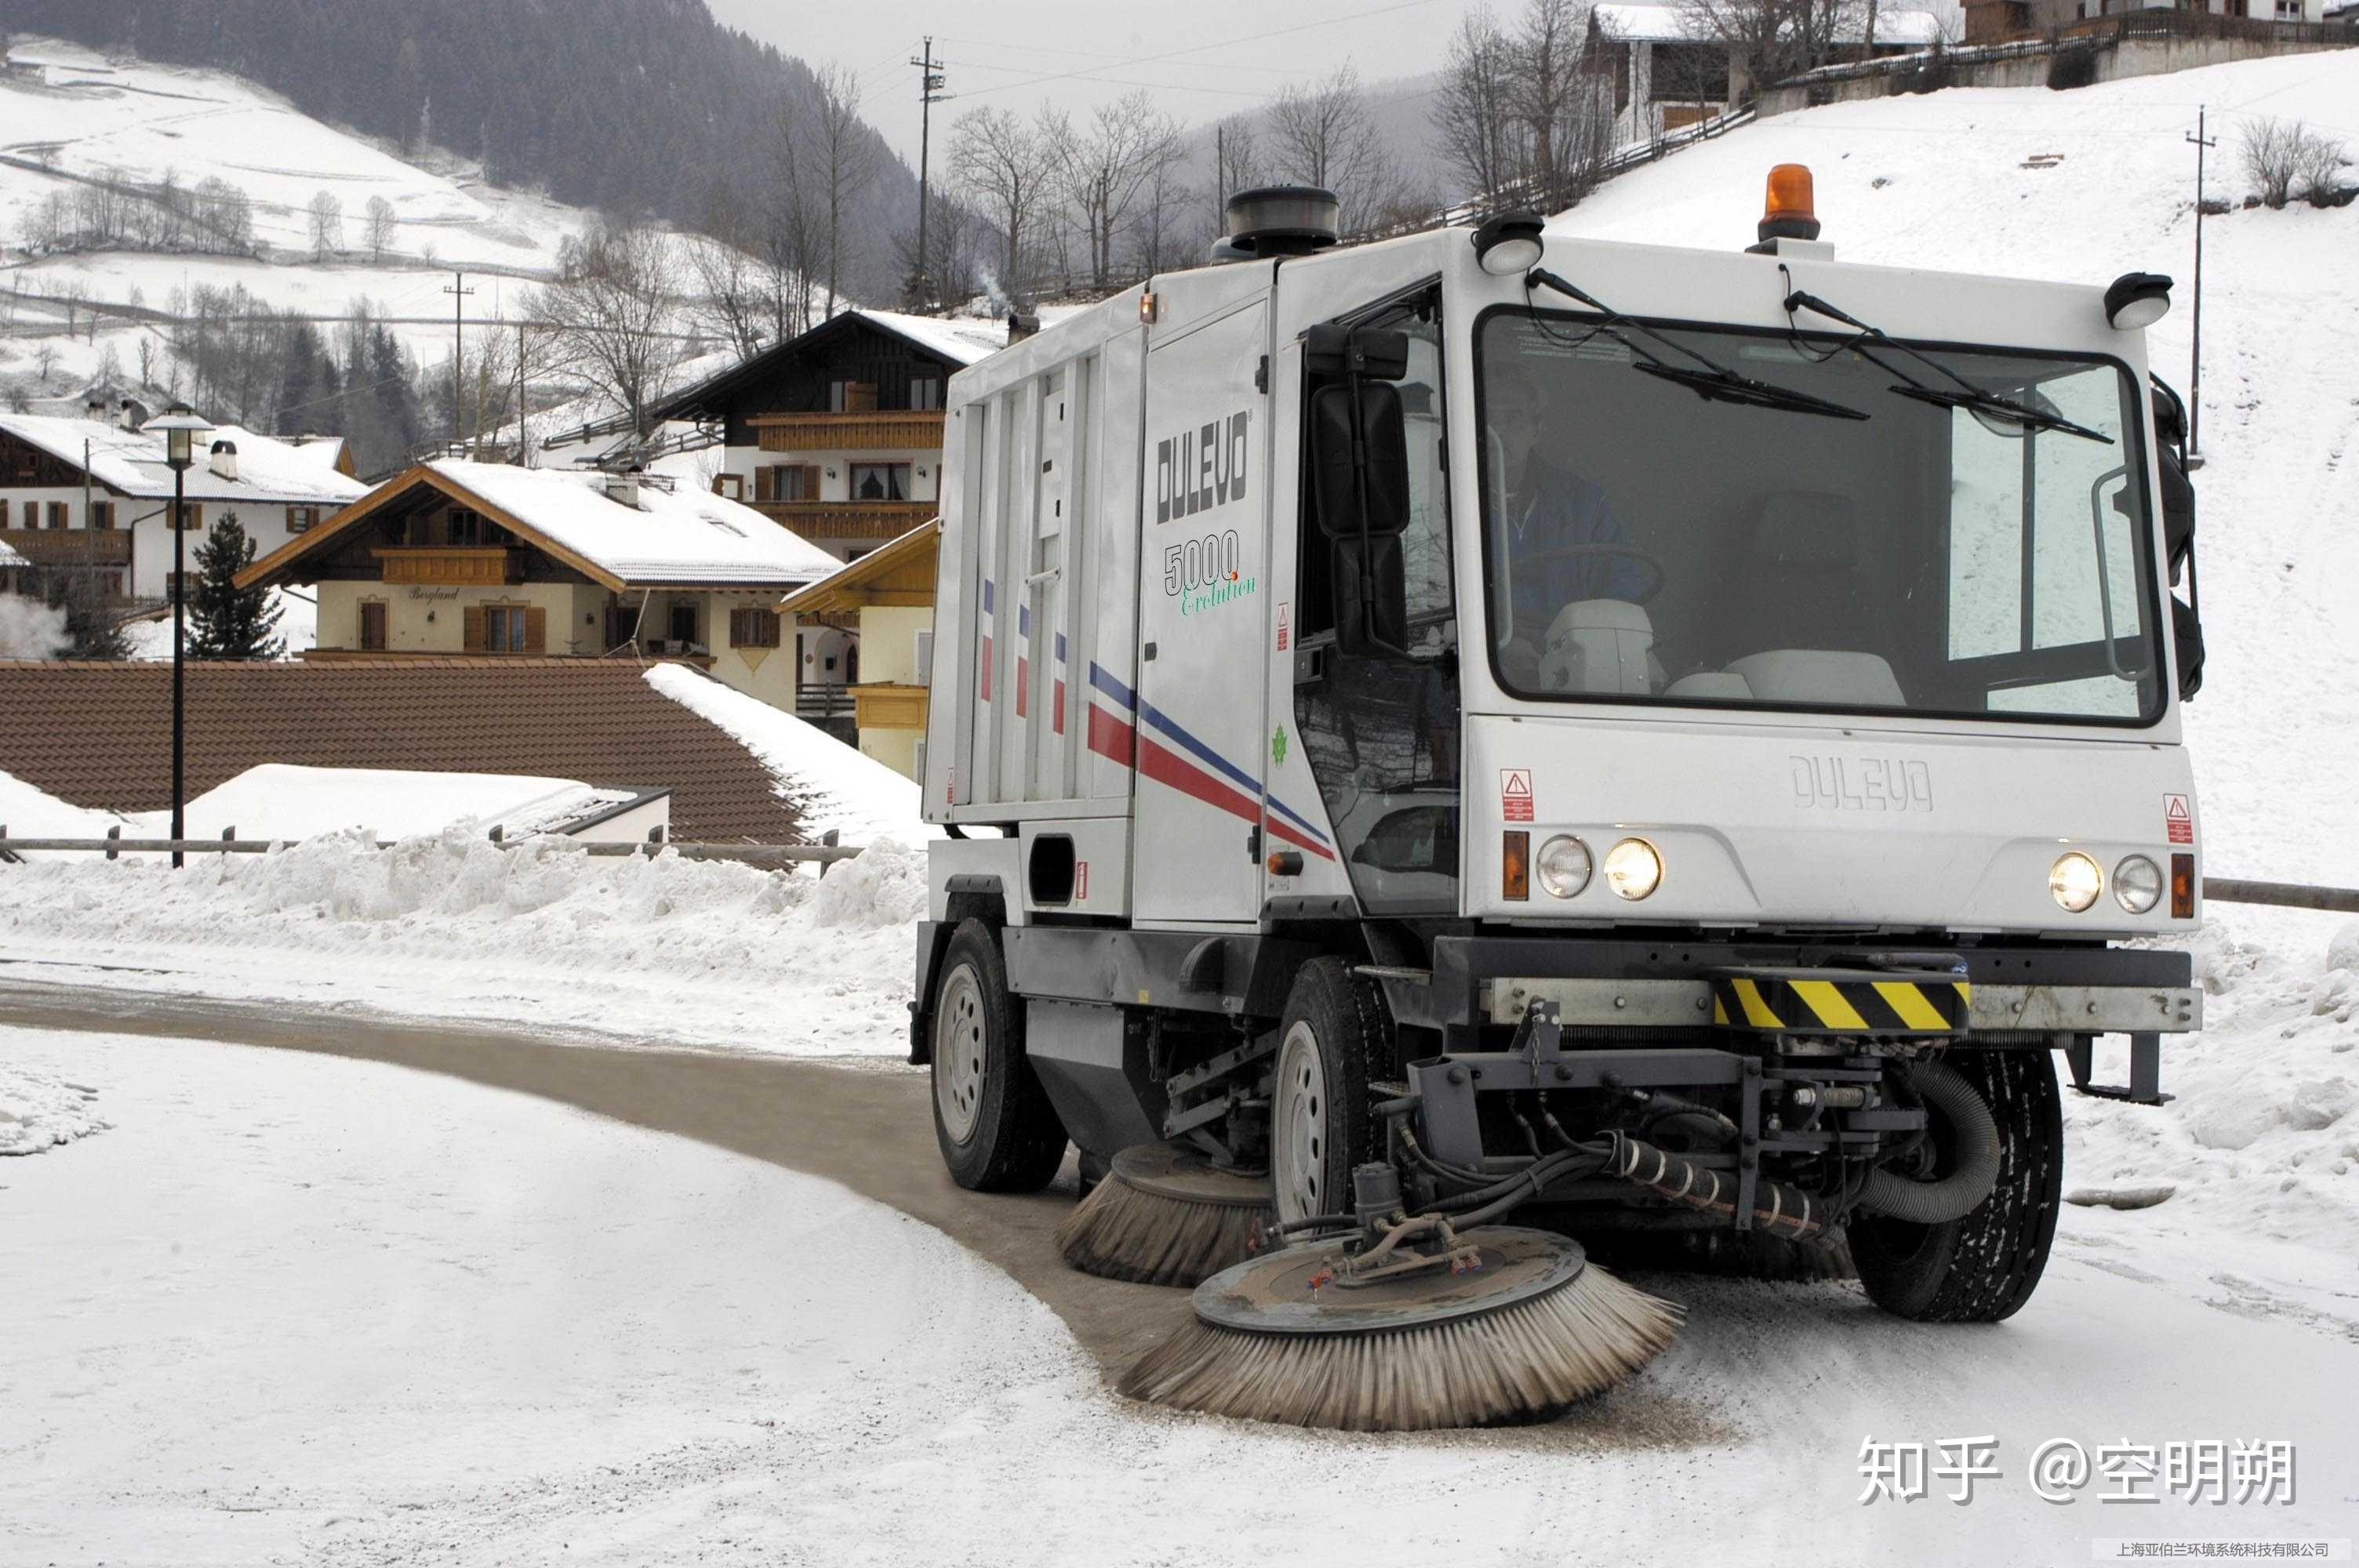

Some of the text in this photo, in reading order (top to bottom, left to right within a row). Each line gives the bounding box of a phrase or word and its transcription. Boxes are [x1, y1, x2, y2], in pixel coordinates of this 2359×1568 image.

[1157, 410, 1247, 524] DULEVO
[1165, 529, 1239, 597] 5000
[1789, 755, 1933, 812] DULEVO
